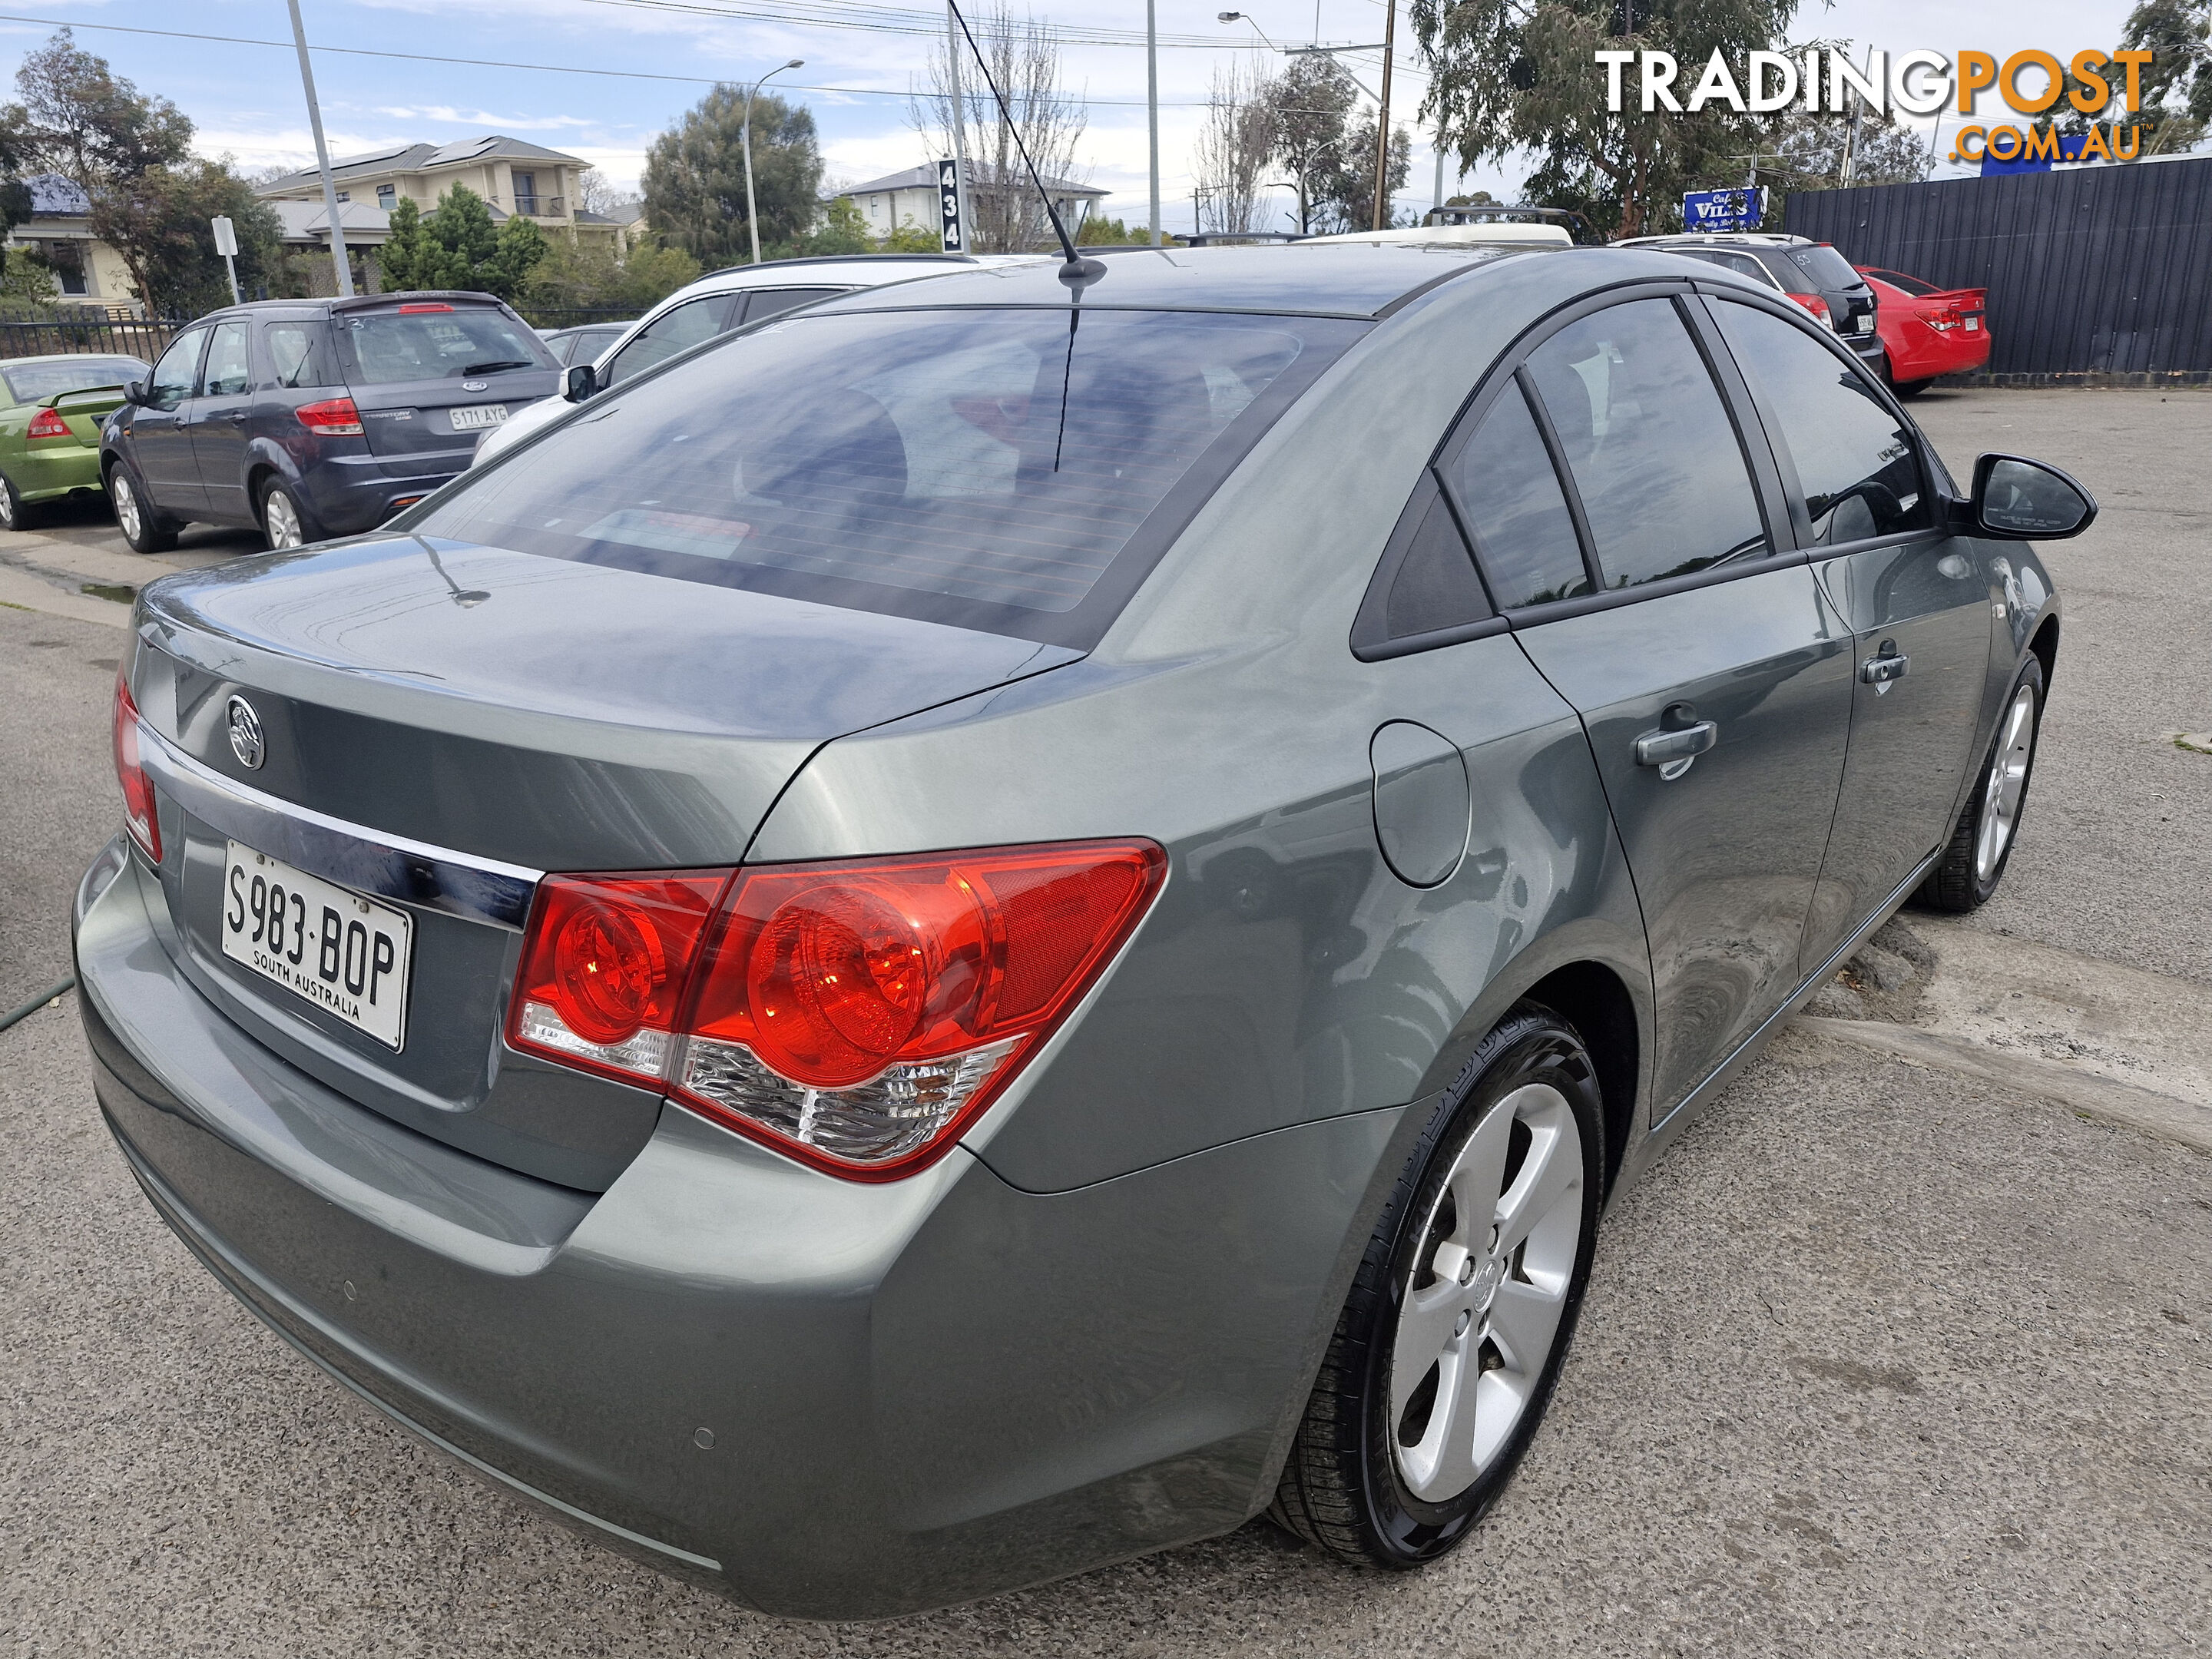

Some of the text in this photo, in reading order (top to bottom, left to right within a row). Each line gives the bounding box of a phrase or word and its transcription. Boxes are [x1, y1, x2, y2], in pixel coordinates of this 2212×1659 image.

[942, 166, 959, 245] 434
[253, 950, 360, 1021] SOUTH AUSTRALIA
